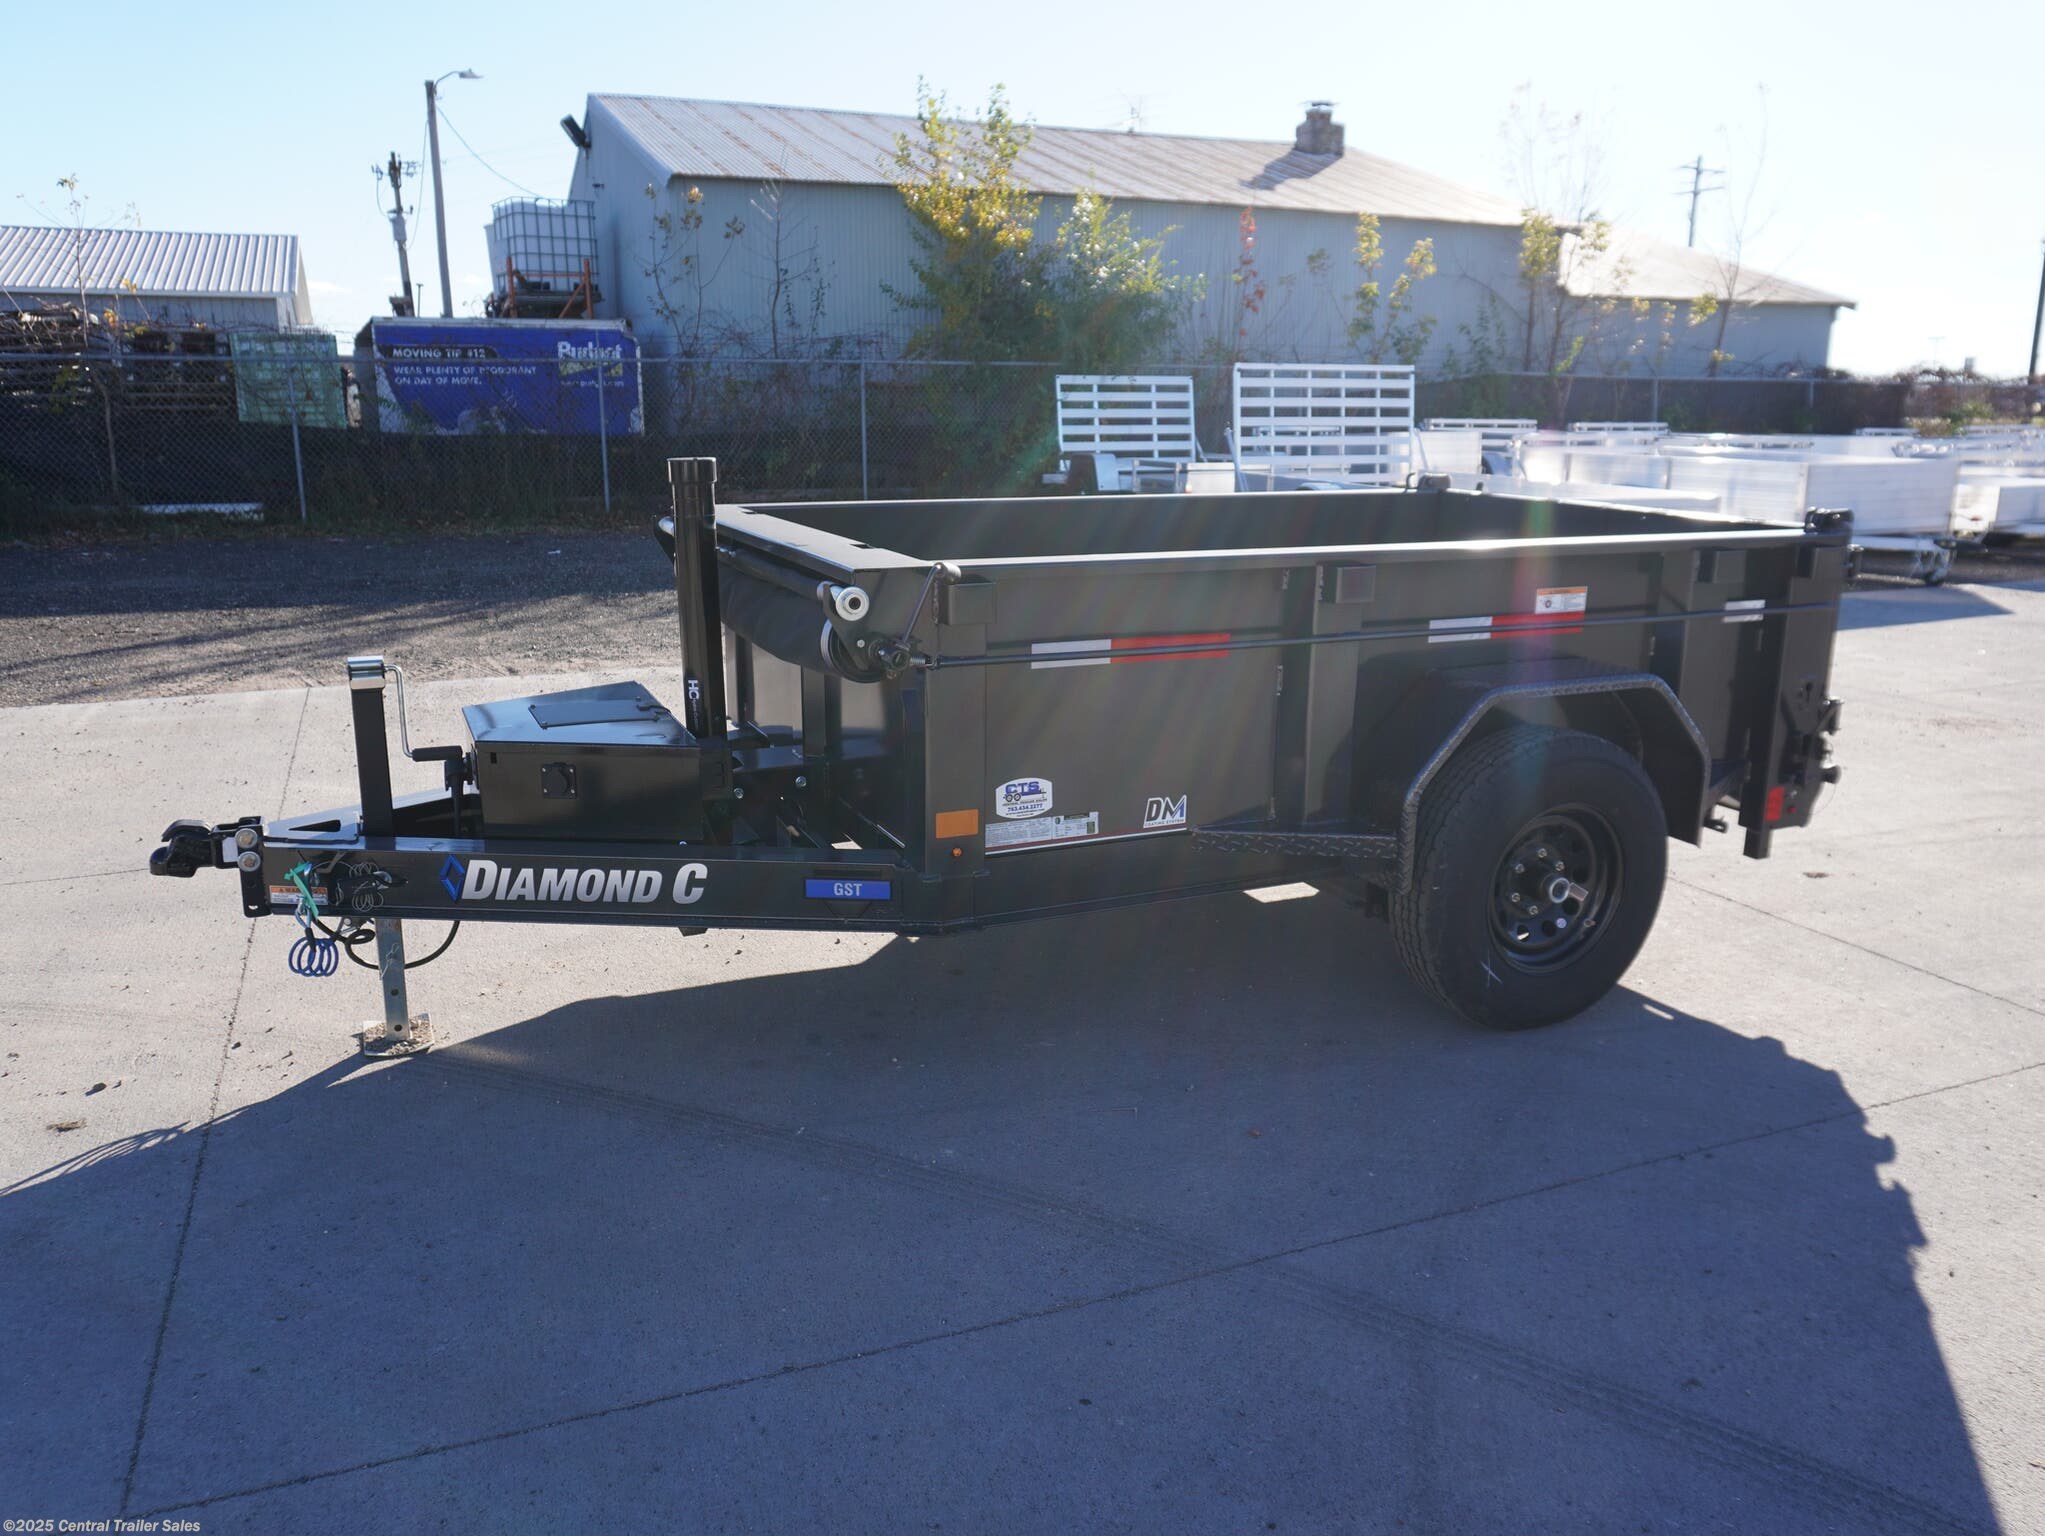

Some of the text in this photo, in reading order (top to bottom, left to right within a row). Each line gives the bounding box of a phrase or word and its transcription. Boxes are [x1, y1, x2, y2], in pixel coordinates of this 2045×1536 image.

[392, 348, 486, 358] MOVING TIP #12
[393, 366, 422, 375] WEAR
[426, 366, 460, 375] PLENTY
[462, 366, 475, 375] OF
[395, 376, 411, 385] ON
[413, 376, 432, 385] DAY
[435, 376, 447, 385] OF
[1005, 781, 1040, 795] CTS
[1146, 796, 1185, 821] DM
[461, 859, 708, 905] DIAMOND C
[833, 882, 863, 897] GST
